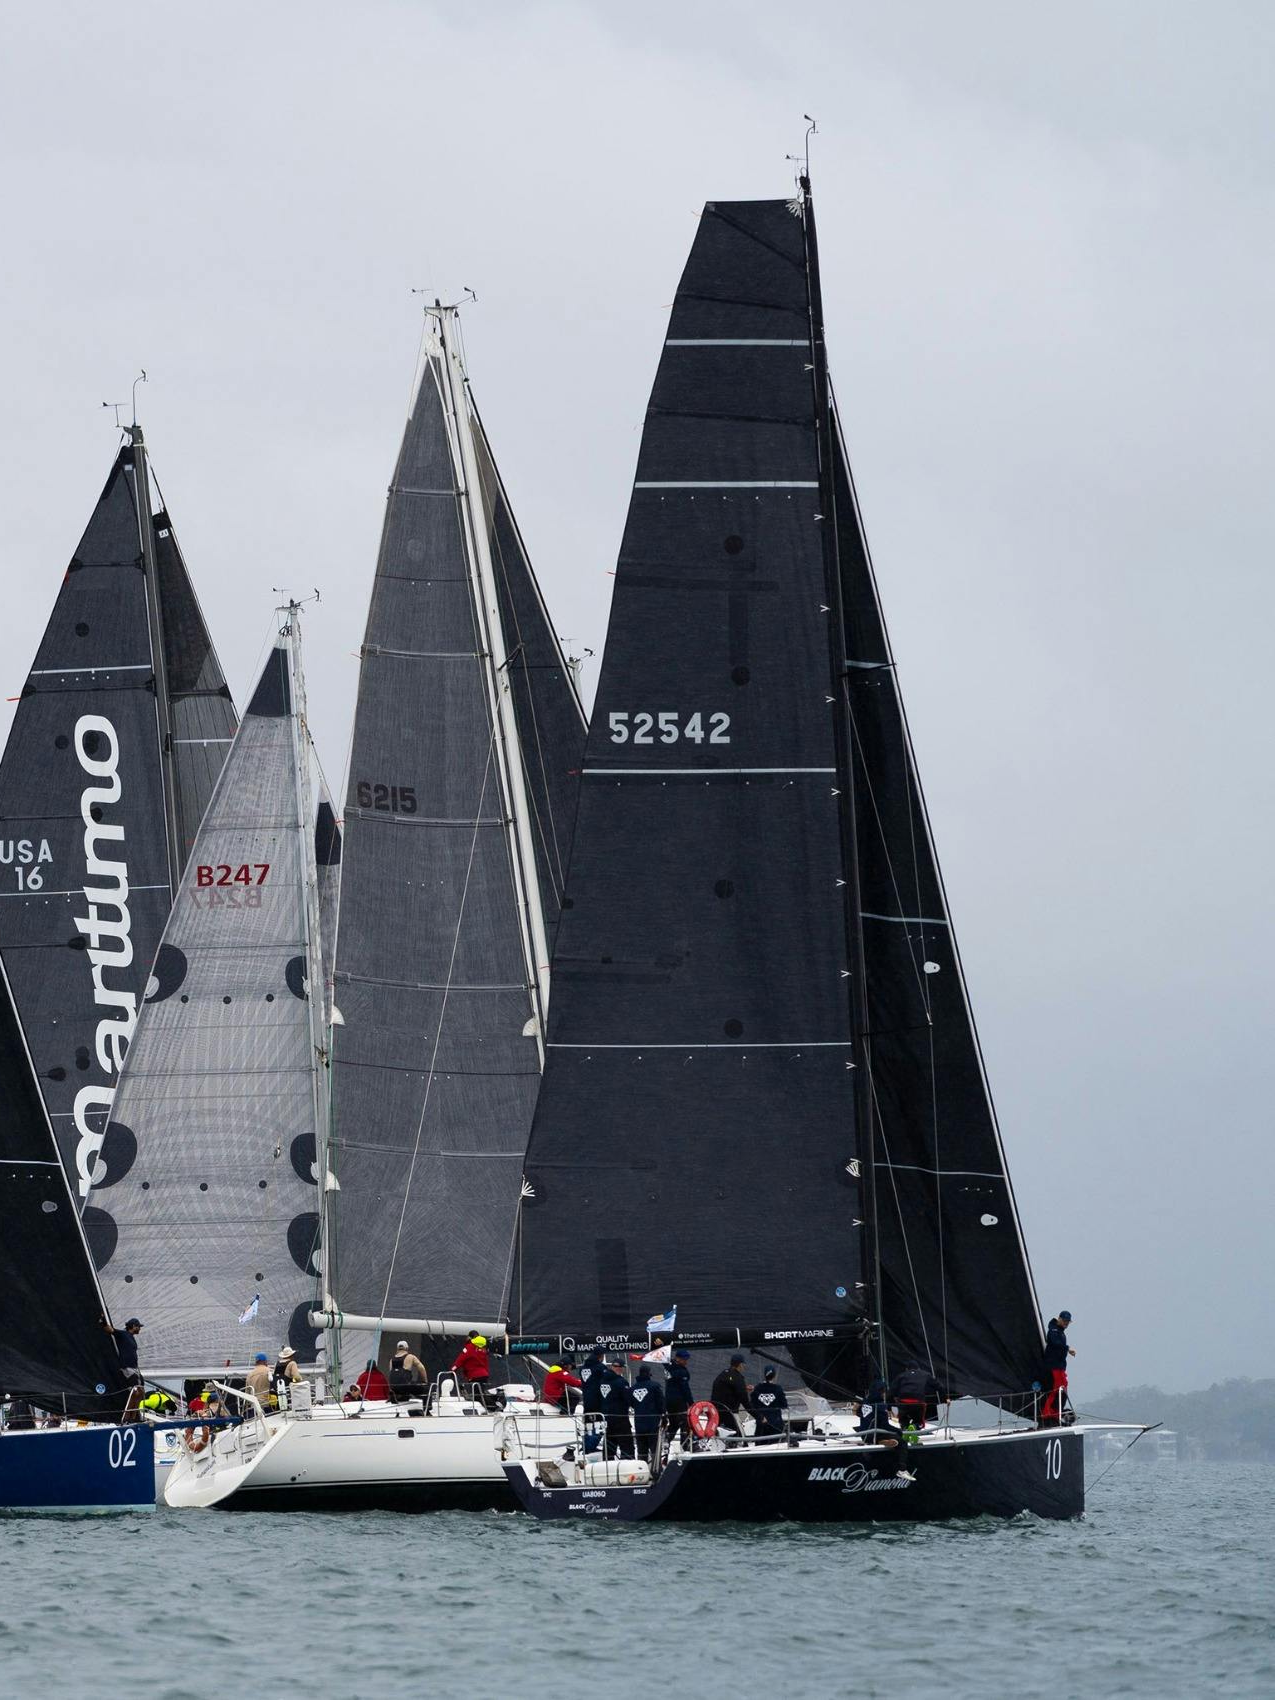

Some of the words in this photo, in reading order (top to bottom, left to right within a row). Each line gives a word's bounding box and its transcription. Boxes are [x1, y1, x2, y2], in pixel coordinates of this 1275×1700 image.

[609, 712, 731, 744] 52542
[357, 781, 417, 813] 6215
[15, 866, 44, 890] 16
[197, 864, 270, 887] B247
[596, 1335, 629, 1344] QUALITY
[609, 1342, 649, 1351] CLOTHING
[109, 1428, 136, 1468] 02
[1045, 1438, 1062, 1480] 10
[807, 1467, 848, 1481] BLACK
